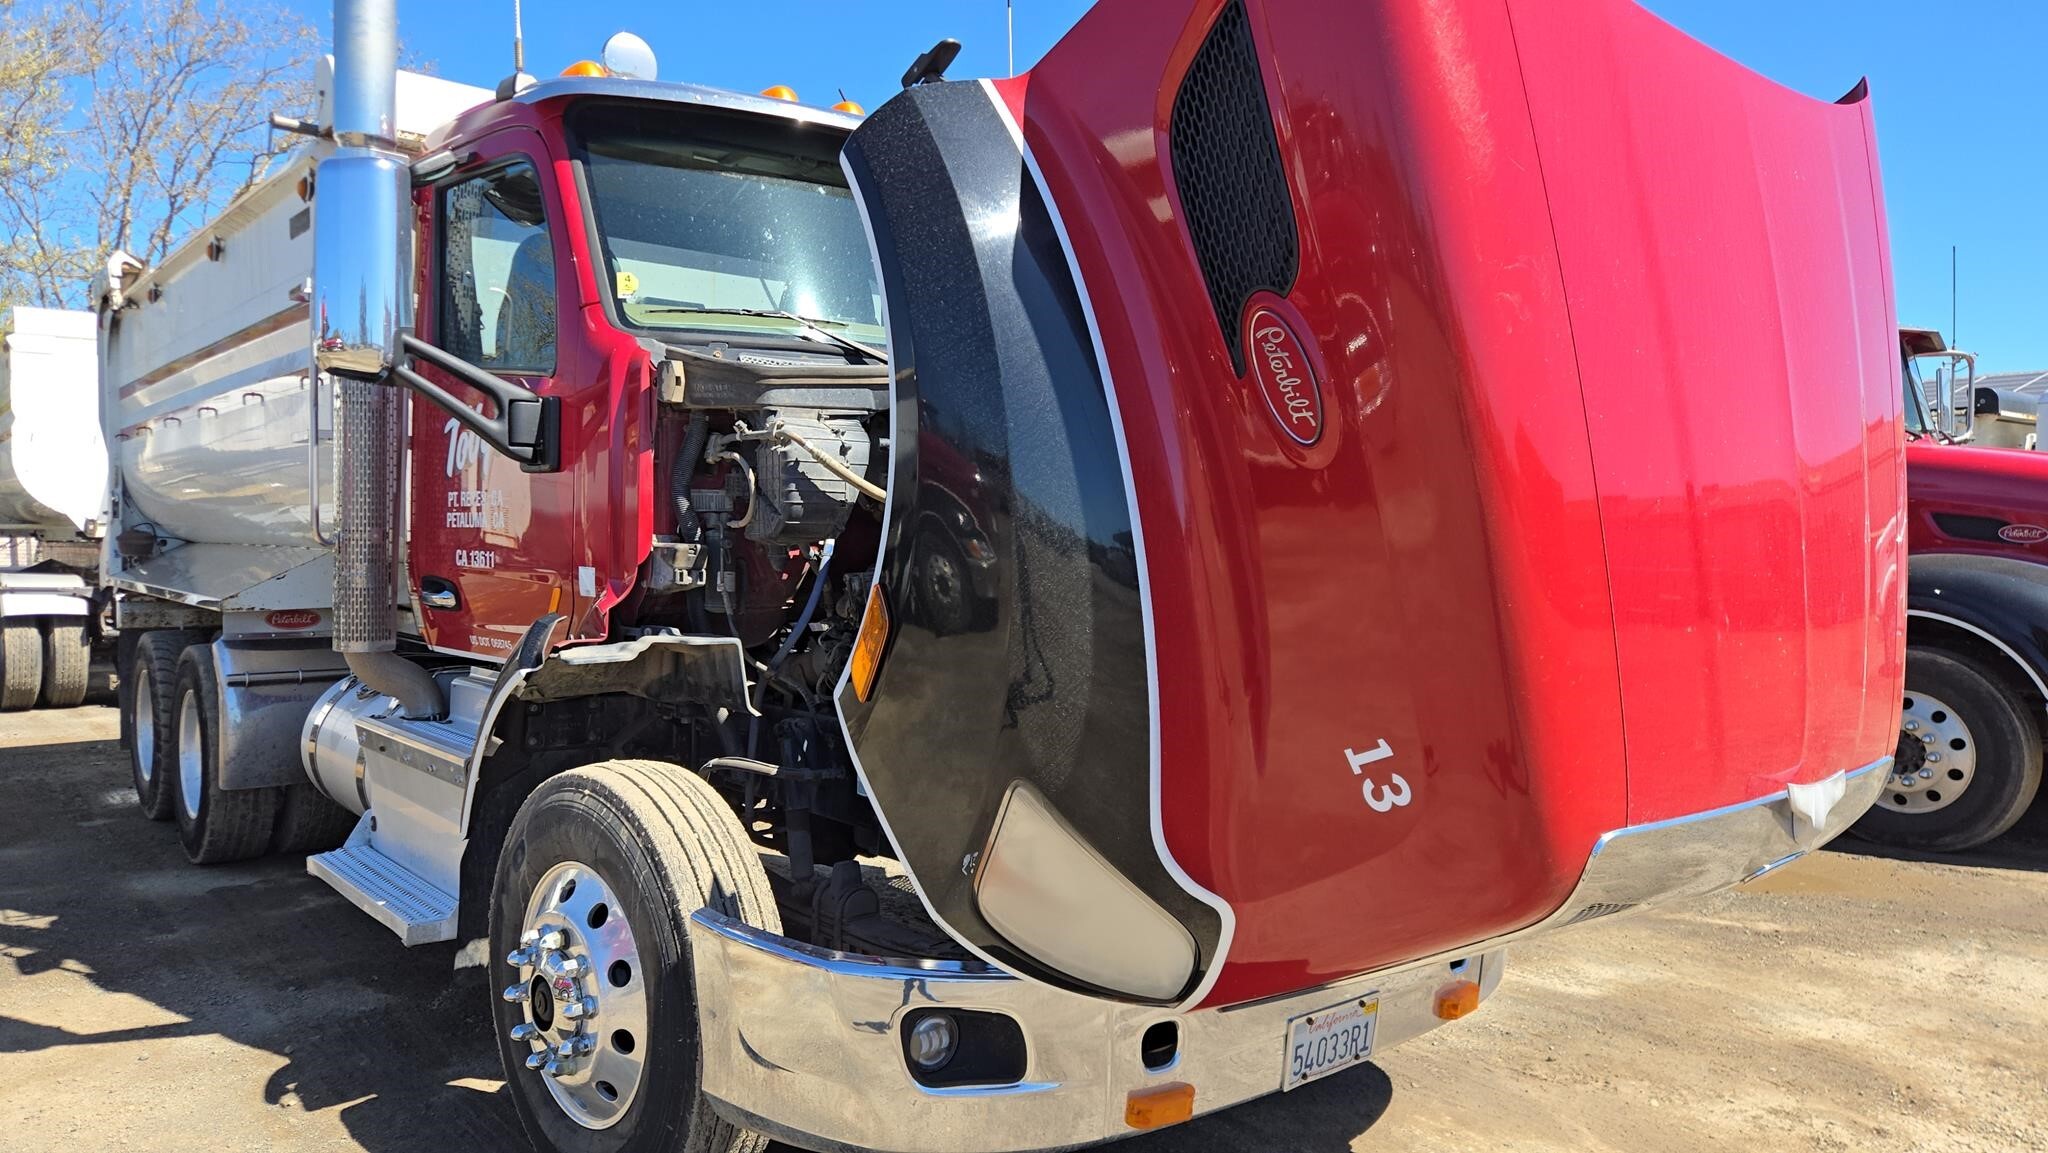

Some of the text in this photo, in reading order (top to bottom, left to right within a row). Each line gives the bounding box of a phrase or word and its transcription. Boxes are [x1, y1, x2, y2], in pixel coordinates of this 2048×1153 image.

[1255, 326, 1317, 427] Peterbilt
[446, 511, 487, 528] PETALUMA
[2003, 527, 2042, 538] Peterbilt
[455, 549, 496, 568] CA 13611
[271, 613, 316, 625] Peterbilt
[1343, 738, 1412, 813] 13
[1293, 1021, 1369, 1077] 54033R1
